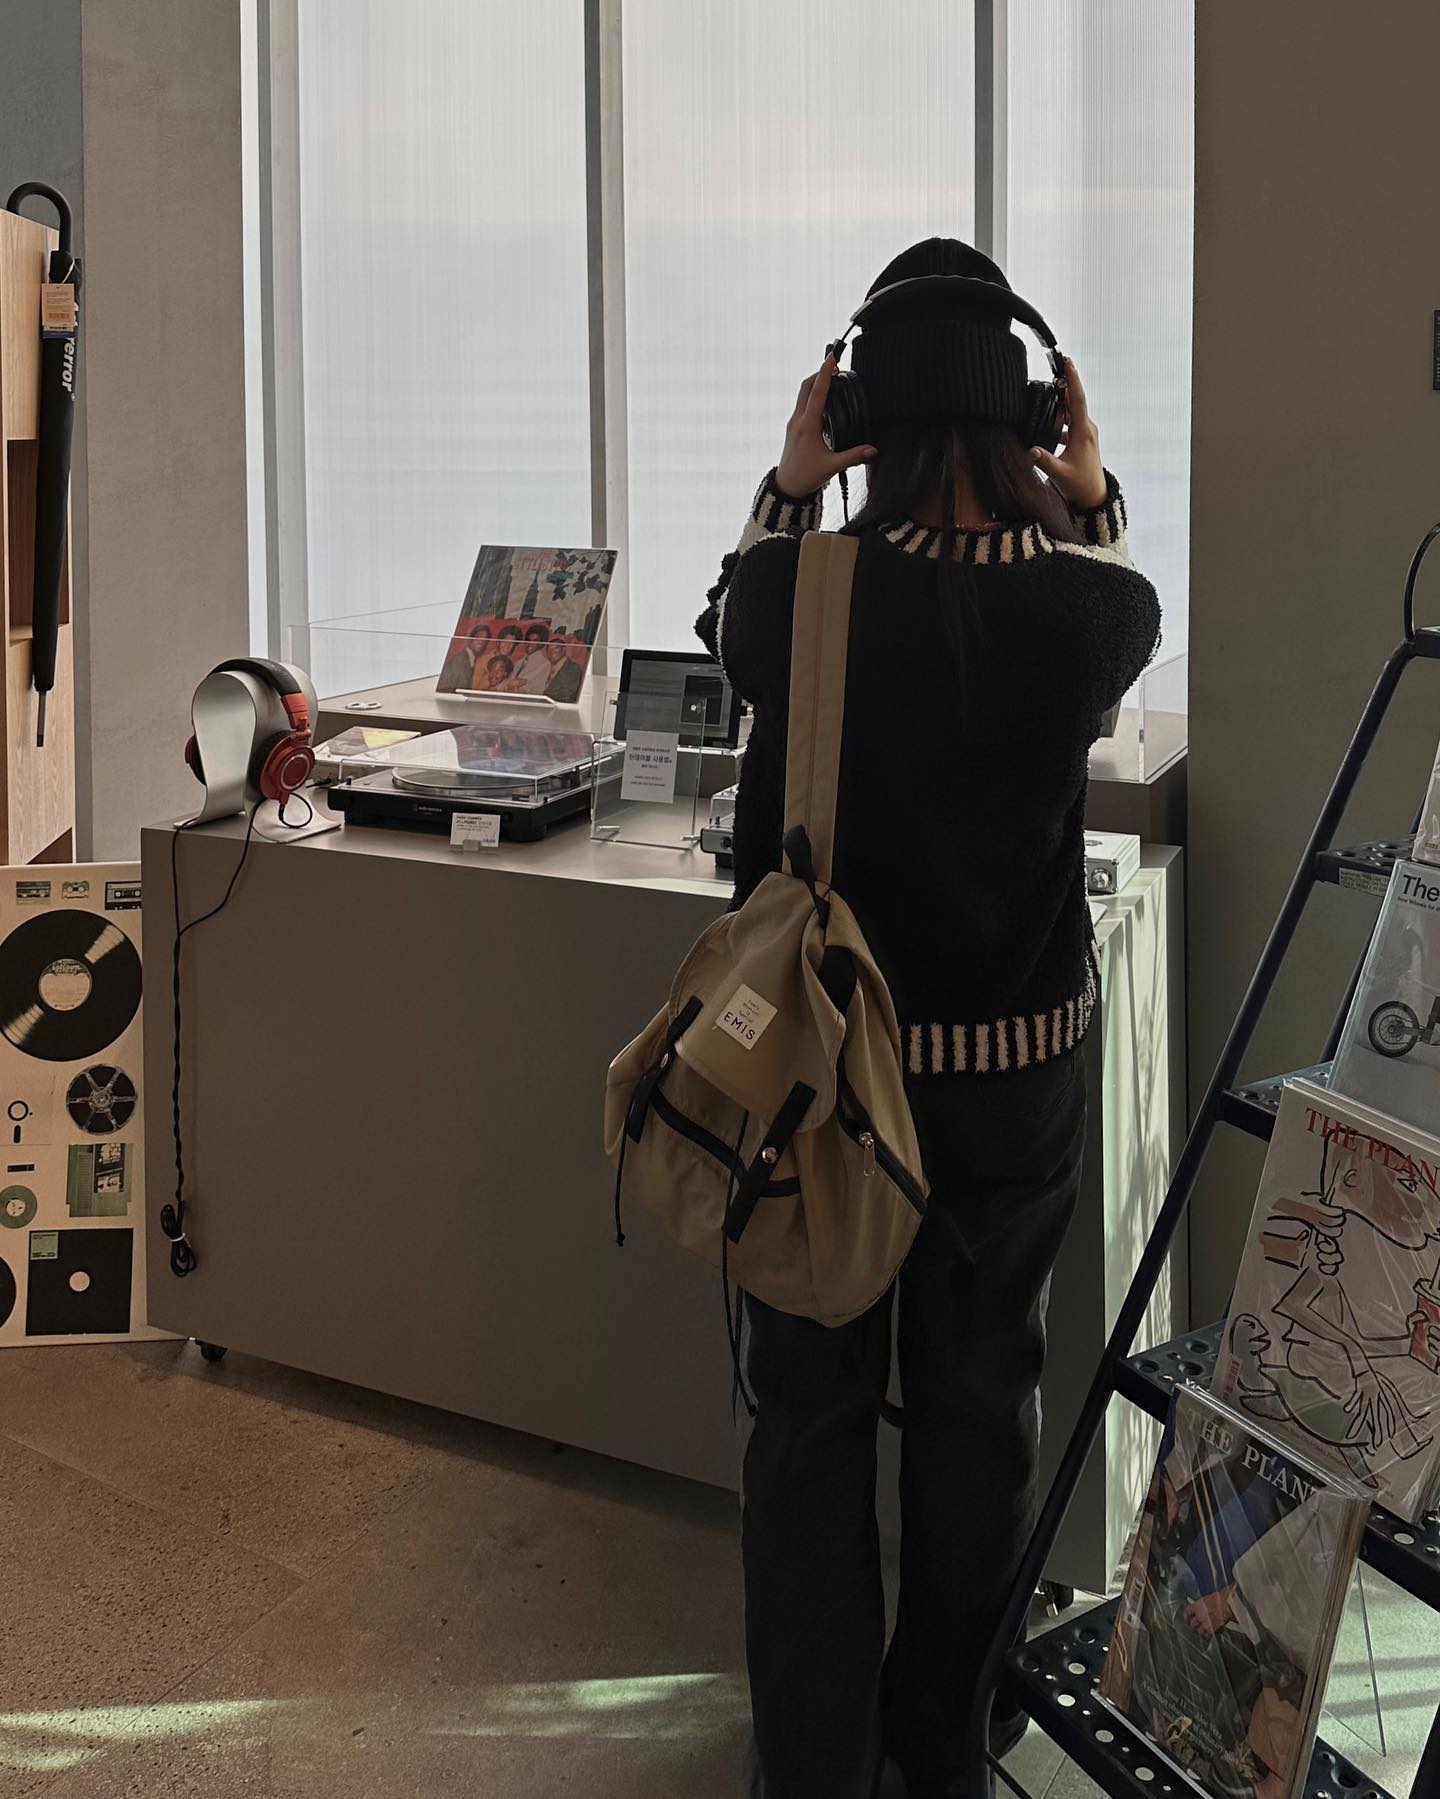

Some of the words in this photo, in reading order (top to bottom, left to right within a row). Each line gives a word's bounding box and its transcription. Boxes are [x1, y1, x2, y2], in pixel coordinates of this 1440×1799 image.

[1403, 874, 1440, 902] The
[723, 1011, 755, 1040] EMIS
[1305, 1107, 1358, 1152] THE
[1184, 1407, 1234, 1456] THE
